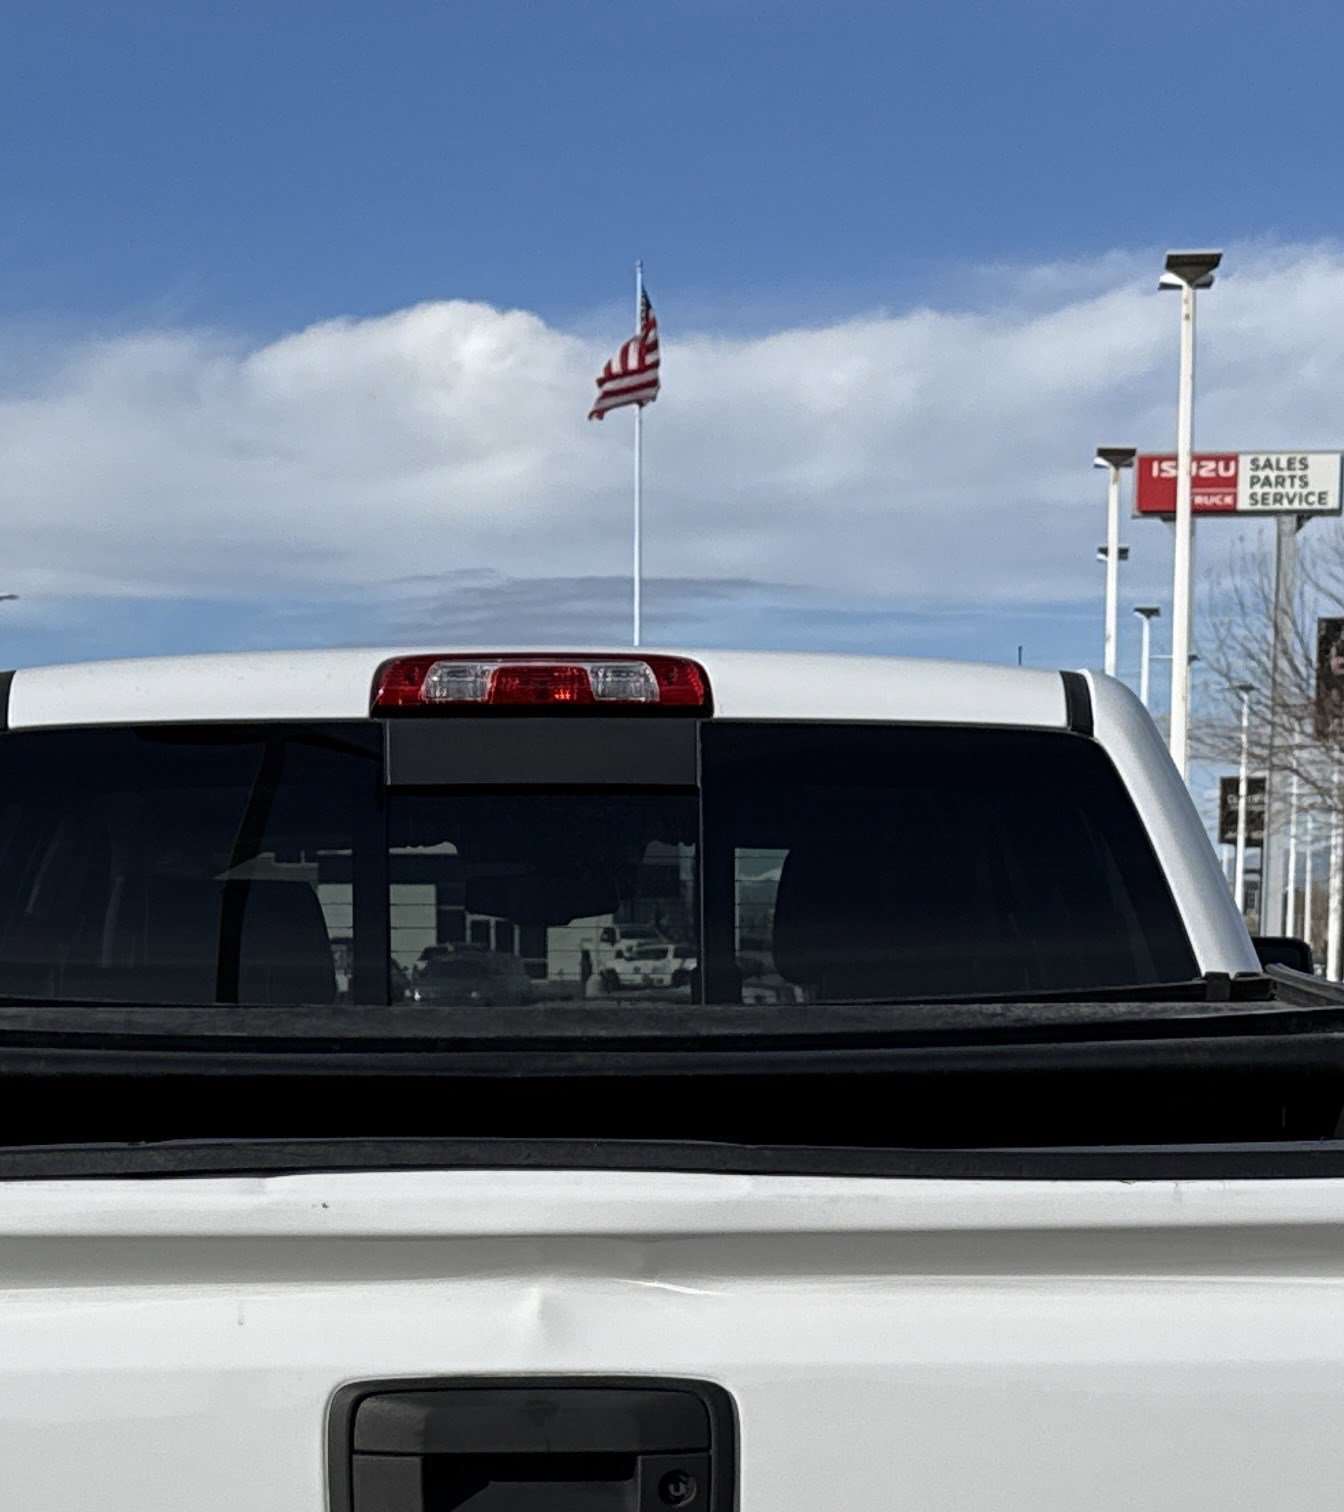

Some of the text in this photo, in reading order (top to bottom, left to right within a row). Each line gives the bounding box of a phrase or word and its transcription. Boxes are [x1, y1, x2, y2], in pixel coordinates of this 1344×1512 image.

[1249, 457, 1309, 472] SALES
[1249, 474, 1309, 489] PARTS
[1249, 491, 1328, 506] SERVICE
